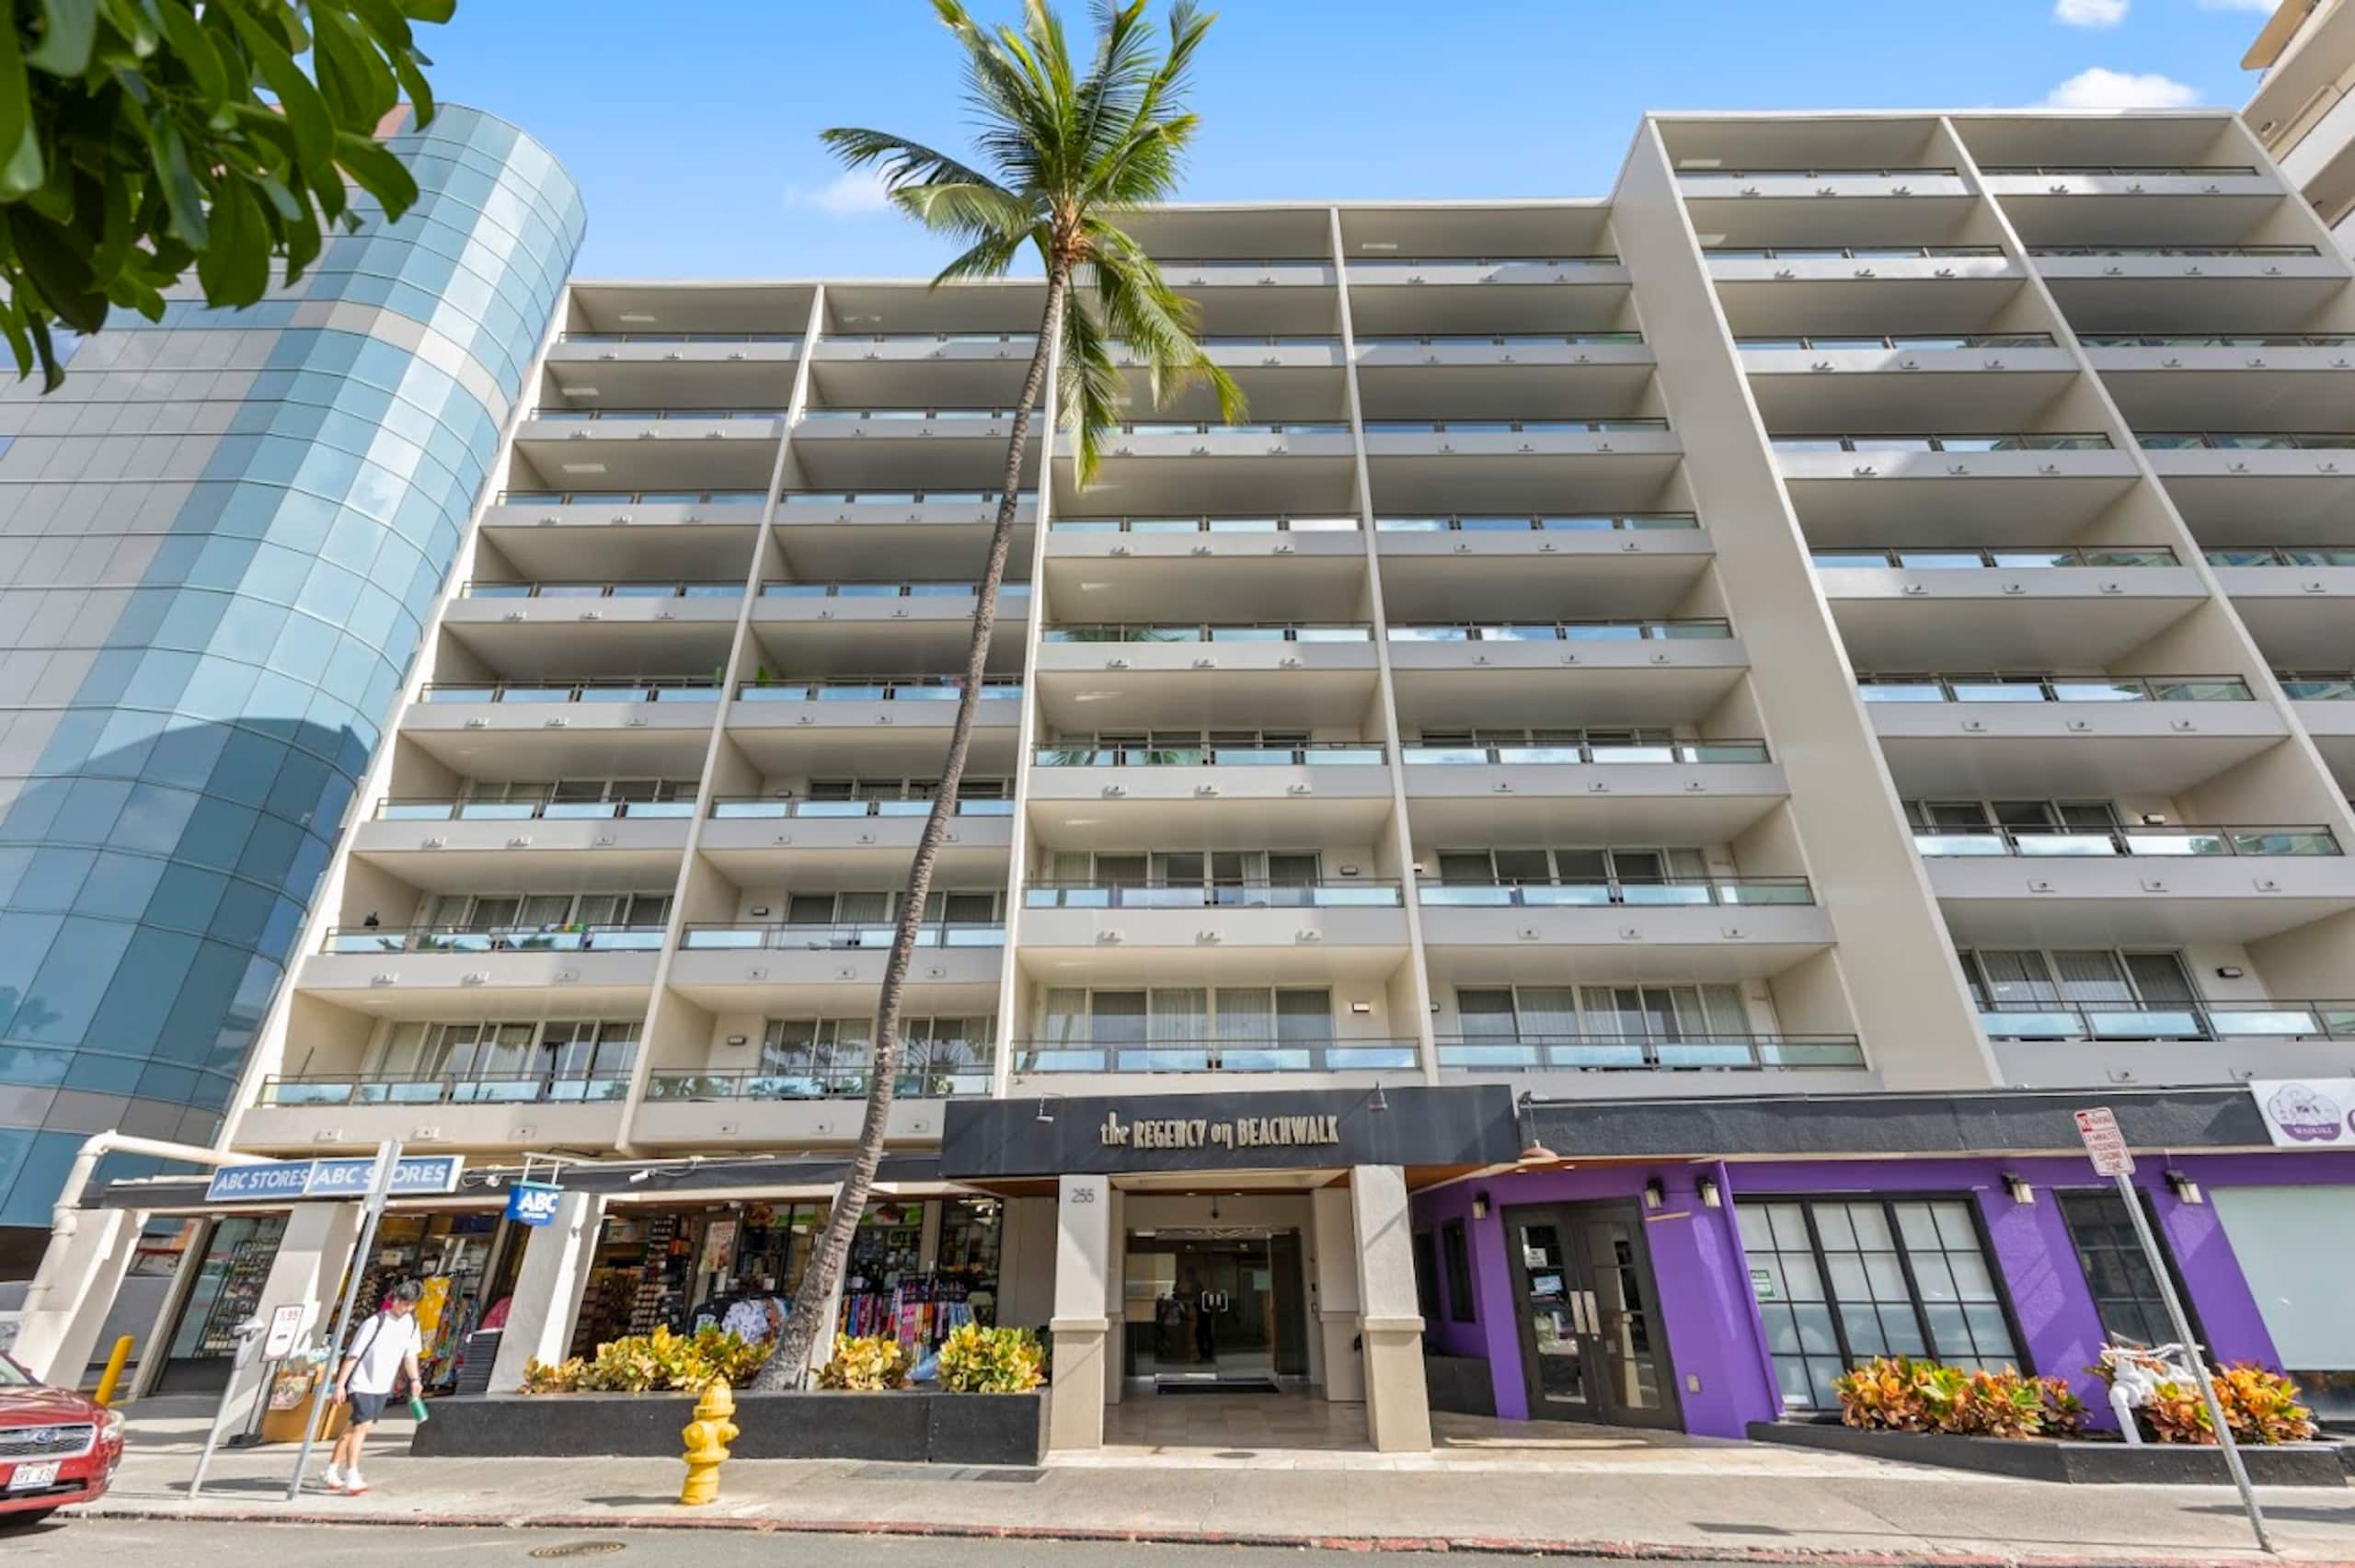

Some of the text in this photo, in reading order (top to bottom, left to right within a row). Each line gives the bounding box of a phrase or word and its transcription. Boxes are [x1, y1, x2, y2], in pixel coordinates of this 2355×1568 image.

[1100, 1111, 1340, 1150] the REGENCY on BEACHWALK
[215, 1168, 309, 1191] ABC STORES
[314, 1162, 447, 1185] ABC SORES
[515, 1191, 559, 1213] ABC
[1071, 1187, 1096, 1203] 255
